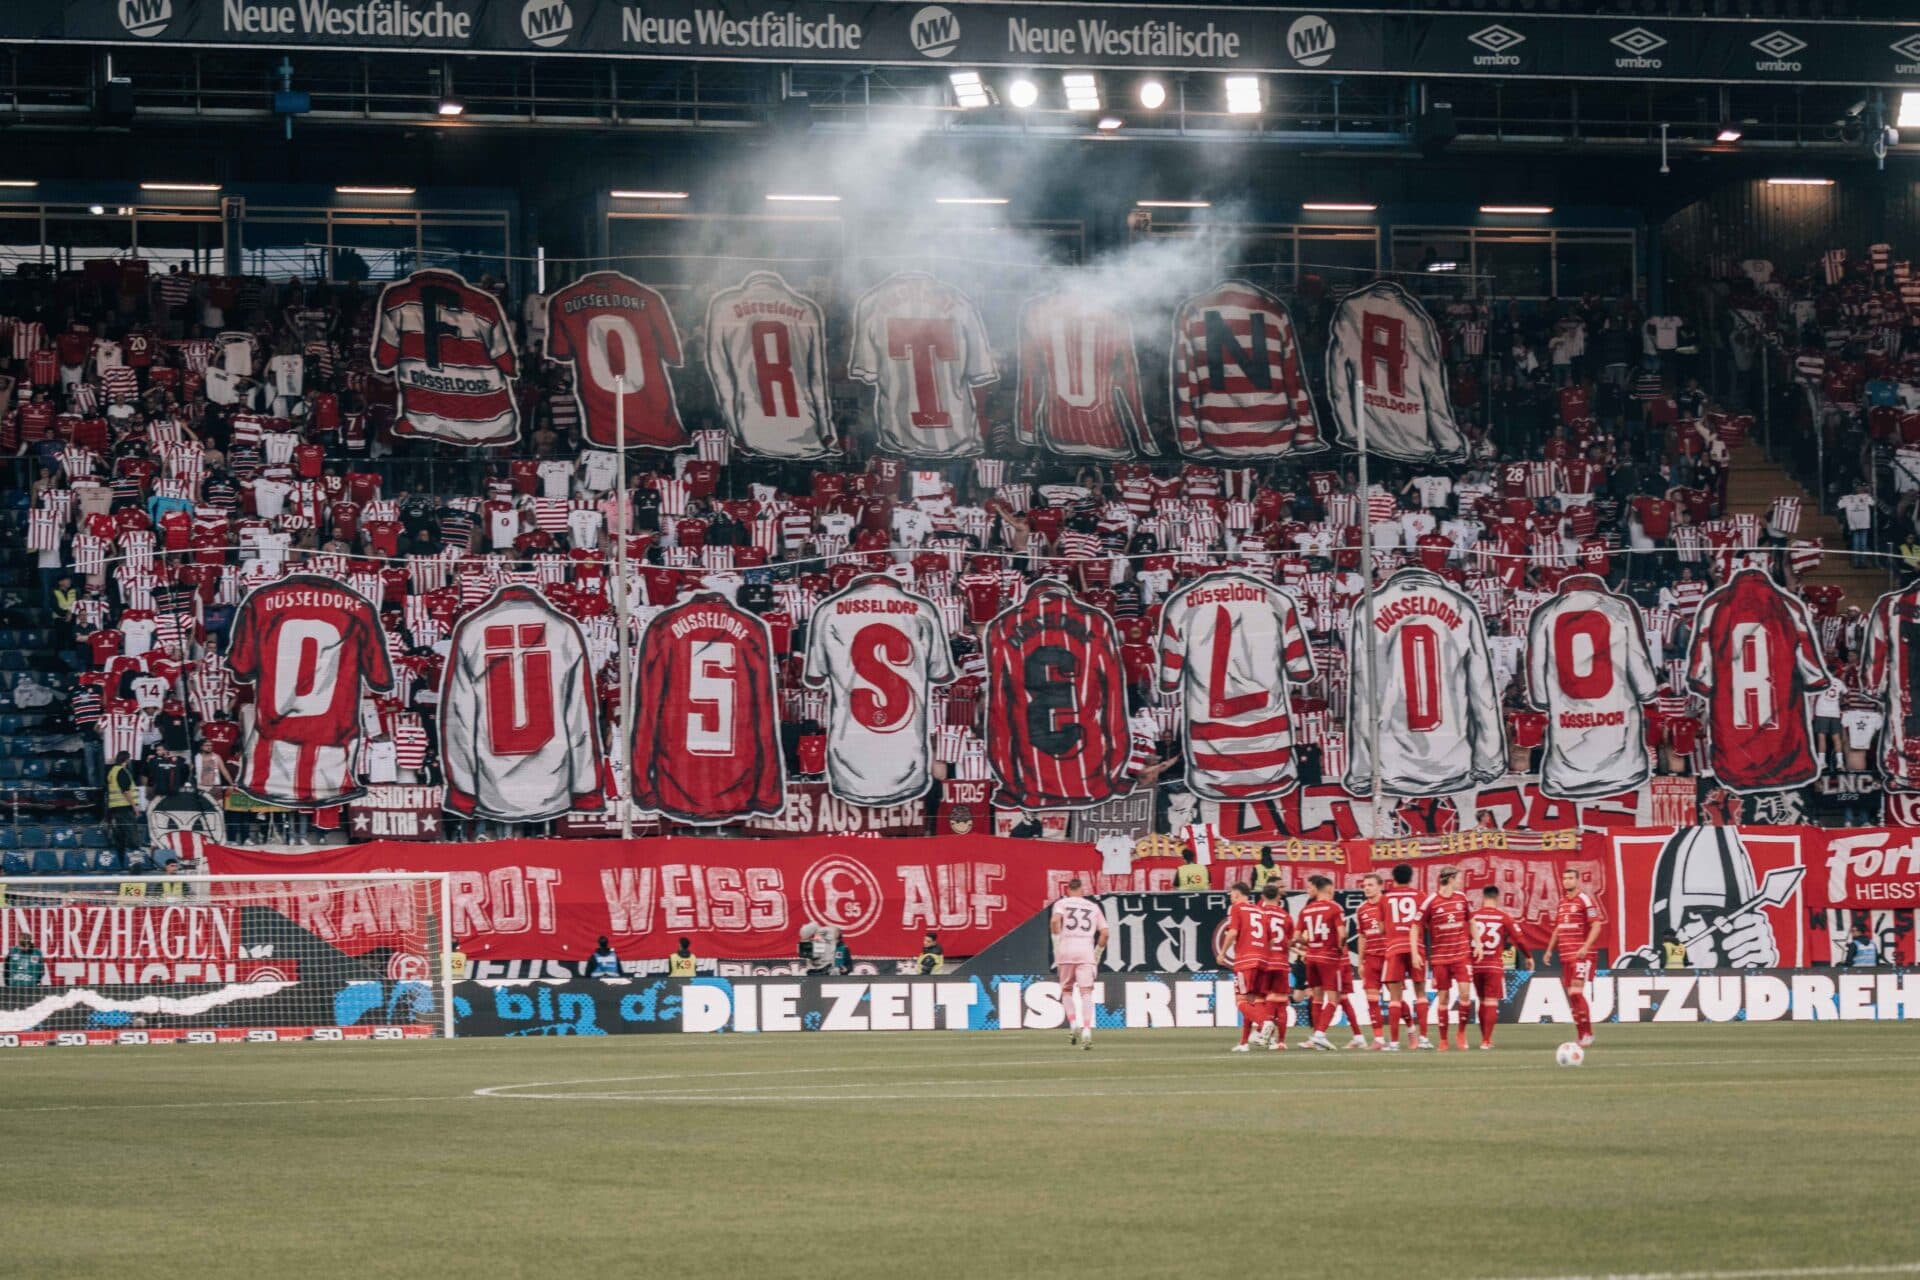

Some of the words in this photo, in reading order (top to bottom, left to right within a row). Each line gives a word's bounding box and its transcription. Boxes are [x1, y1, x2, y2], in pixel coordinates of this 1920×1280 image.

[223, 1, 296, 33] Neue
[300, 0, 471, 38] Westfälische
[525, 3, 571, 32] NW
[622, 7, 691, 45] Neue
[695, 9, 861, 50] Westfälische
[916, 15, 955, 45] NW
[1008, 17, 1075, 54] Neue
[1078, 19, 1240, 58] Westfälische
[1294, 24, 1331, 57] NW
[1473, 54, 1520, 66] umbro
[1615, 57, 1662, 69] umbro
[1756, 60, 1801, 72] umbro
[130, 337, 147, 351] 20
[325, 475, 341, 490] 18
[1315, 480, 1331, 494] 10
[1506, 468, 1525, 483] 28
[265, 591, 363, 612] DÜSSELDORF
[836, 598, 919, 616] DÜSSELDORF
[1374, 595, 1464, 634] DÜSSELDORF
[670, 612, 750, 642] DÜSSELDORF
[141, 684, 161, 698] 14
[1822, 773, 1874, 795] LNC
[1186, 874, 1202, 885] K9
[449, 864, 561, 936] ROT
[600, 863, 789, 936] WEISS
[896, 862, 1007, 932] AUF
[1388, 896, 1416, 923] 19
[1065, 907, 1093, 933] 33
[1304, 914, 1330, 942] 14
[676, 959, 692, 970] K9
[682, 984, 801, 1033] DIE
[820, 983, 978, 1031] ZEIT
[1000, 982, 1104, 1029] IST
[1519, 974, 1920, 1024] AUFZUDREH
